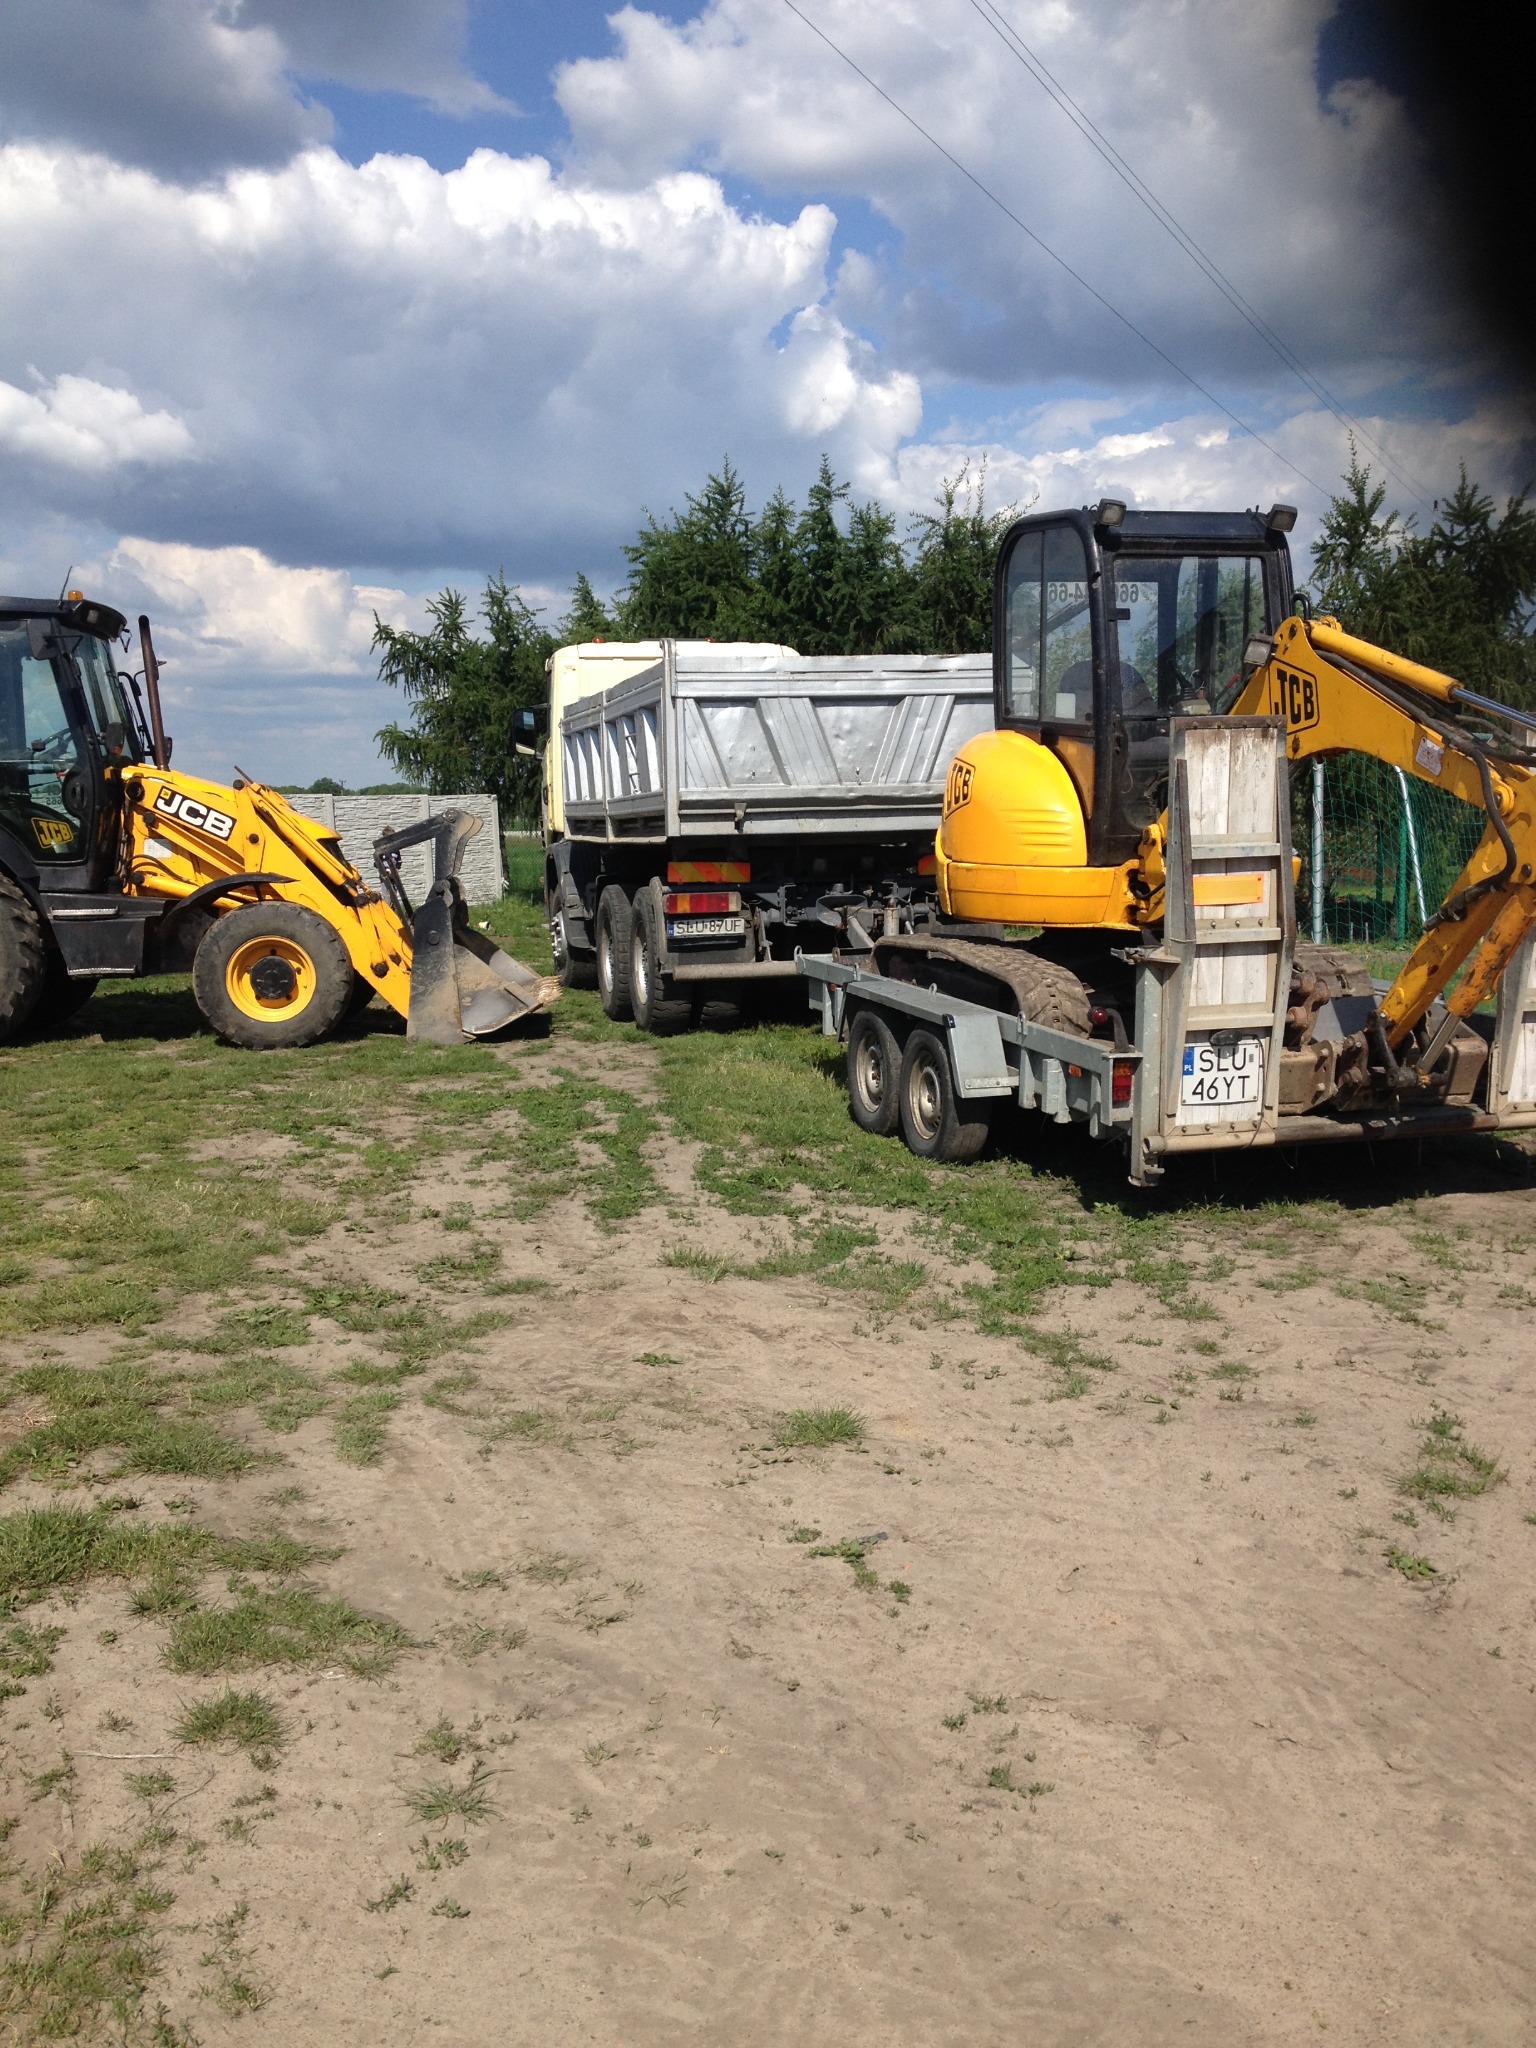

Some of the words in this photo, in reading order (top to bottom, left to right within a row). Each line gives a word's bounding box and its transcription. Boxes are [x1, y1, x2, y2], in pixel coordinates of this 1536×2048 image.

[1274, 668, 1314, 724] JCB
[946, 763, 971, 811] JCB
[156, 793, 233, 838] JCB
[38, 820, 72, 845] JCB
[676, 920, 705, 934] SLU
[709, 918, 742, 932] 87UF
[1199, 1047, 1247, 1073] SLU
[1191, 1075, 1250, 1101] 46YT
